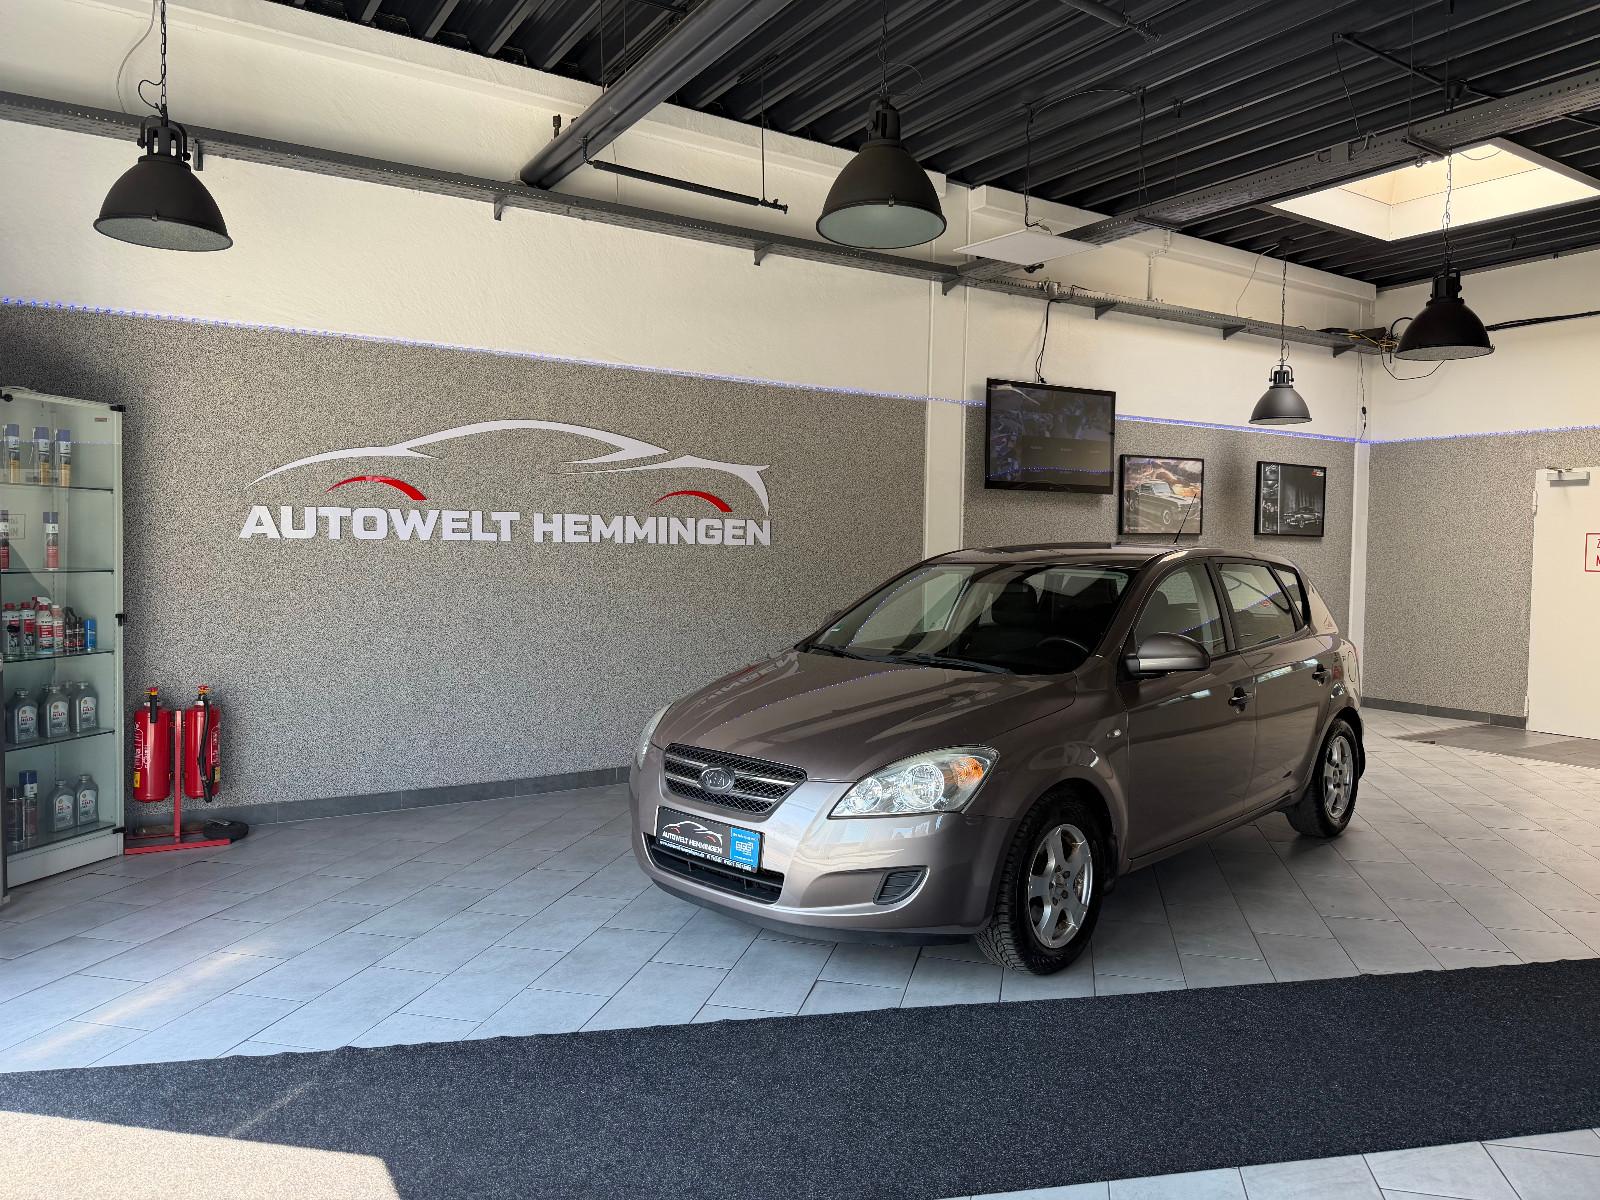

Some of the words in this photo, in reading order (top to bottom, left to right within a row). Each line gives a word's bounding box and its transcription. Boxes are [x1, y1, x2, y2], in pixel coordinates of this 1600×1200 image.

[239, 505, 520, 541] AUTOWELT
[533, 512, 771, 546] HEMMINGEN
[662, 830, 688, 845] AUTOWELT
[689, 837, 723, 854] HEMMINGEN
